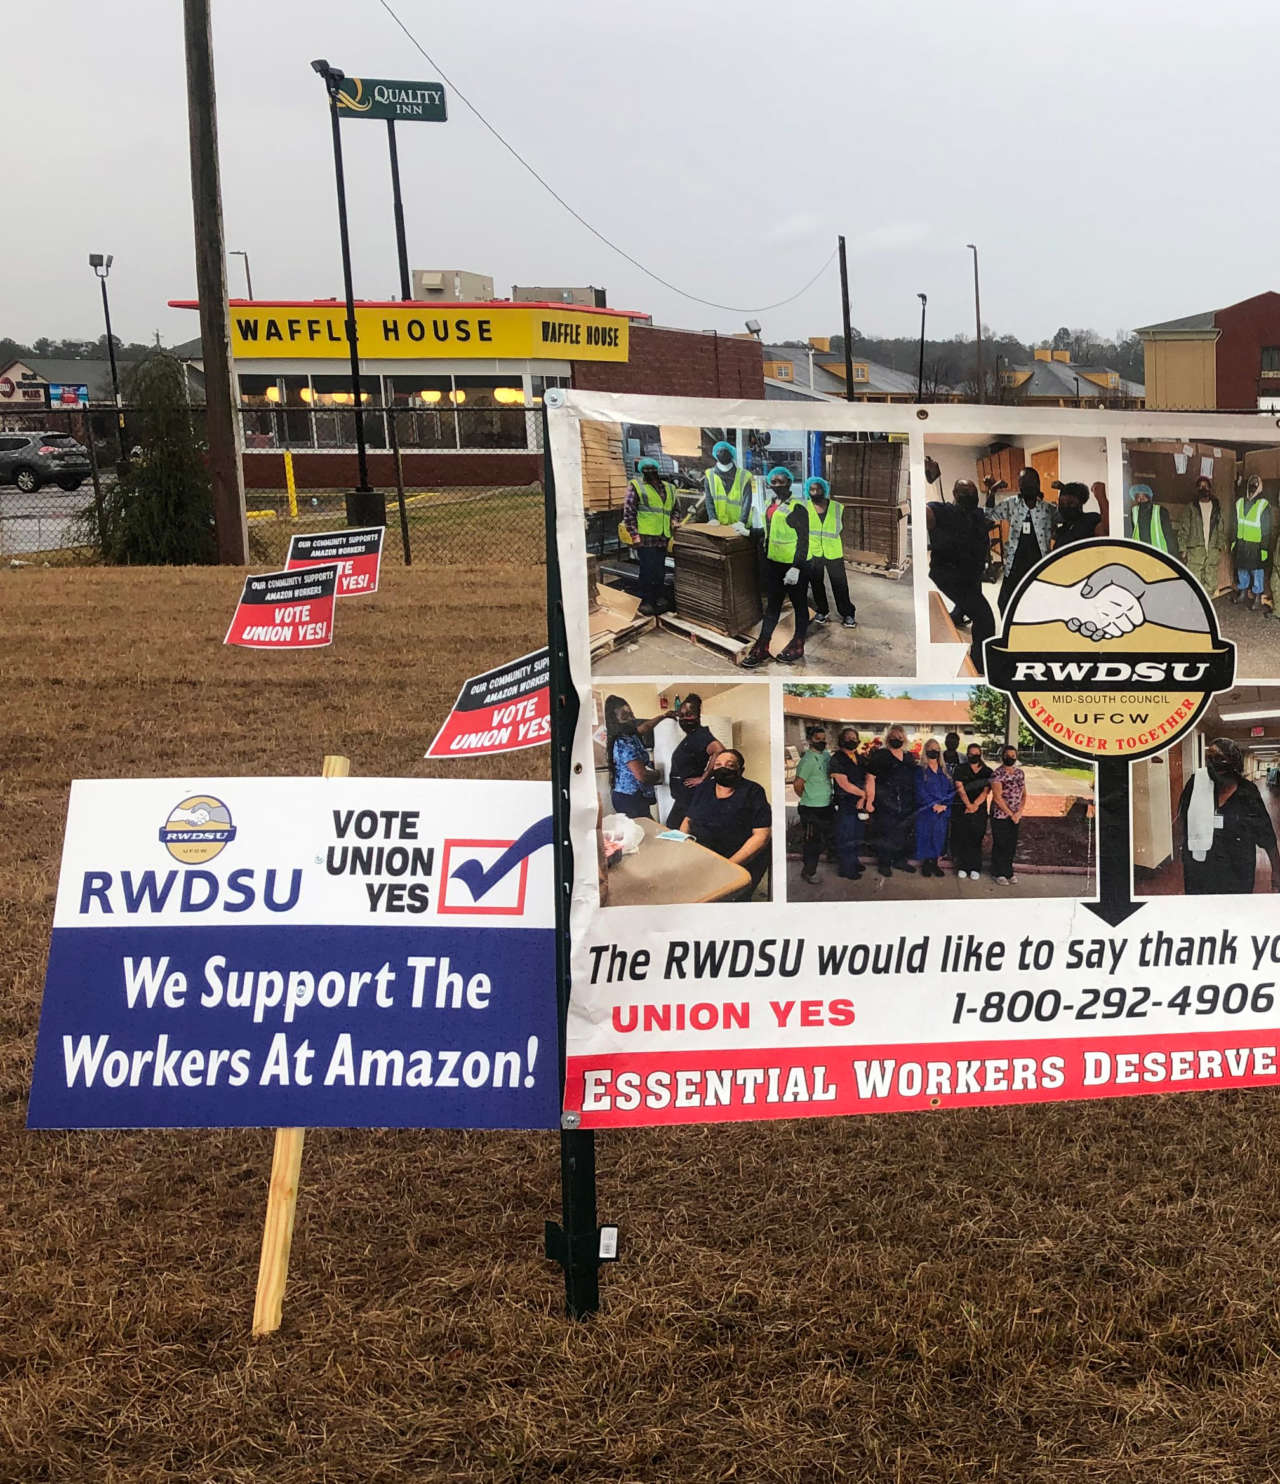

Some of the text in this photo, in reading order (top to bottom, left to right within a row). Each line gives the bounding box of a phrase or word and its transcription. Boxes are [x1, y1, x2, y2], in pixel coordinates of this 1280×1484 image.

[374, 86, 440, 104] QUALITY
[396, 105, 423, 115] INN
[382, 319, 492, 342] HOUSE
[542, 321, 619, 347] WAFFLE HOUSE
[349, 533, 378, 544] SUPPORTS
[310, 546, 366, 557] AMAZON WORKERS
[252, 571, 334, 590] OUR COMMUNITY SUPPORTS
[342, 574, 369, 590] YES!
[265, 586, 322, 600] AMAZON WORKERS
[275, 605, 312, 624] VOTE
[242, 622, 327, 640] UNION YES!
[470, 682, 487, 695] OUR
[489, 665, 532, 688] COMMUNITY
[1012, 662, 1210, 682] RWDSU
[484, 684, 518, 704] AMAZON
[1052, 695, 1170, 704] MID-SOUTH COUNCIL
[492, 697, 538, 727] VOTE
[1074, 713, 1150, 724] UFCW
[1028, 698, 1196, 750] STRONGER TOGETHER
[450, 727, 512, 750] UNION
[166, 832, 228, 840] RWDSU
[333, 810, 420, 840] VOTE
[326, 846, 434, 877] UNION
[79, 868, 303, 914] RWDSU
[366, 882, 430, 914] YES
[588, 943, 648, 984] The
[664, 938, 803, 979] RWDSU
[816, 936, 927, 976] would
[940, 935, 1005, 972] like
[1020, 935, 1055, 971] to
[1066, 936, 1128, 974] say
[1139, 929, 1236, 968] thank
[123, 954, 491, 1023] We Support The
[952, 982, 1275, 1024] 1-800-292-4906
[612, 999, 856, 1032] UNION YES
[62, 1032, 539, 1088] Workers At Amazon!
[580, 1064, 837, 1112] ESSENTIAL
[853, 1055, 1064, 1099] WORKERS
[1083, 1046, 1278, 1086] DESERVE
